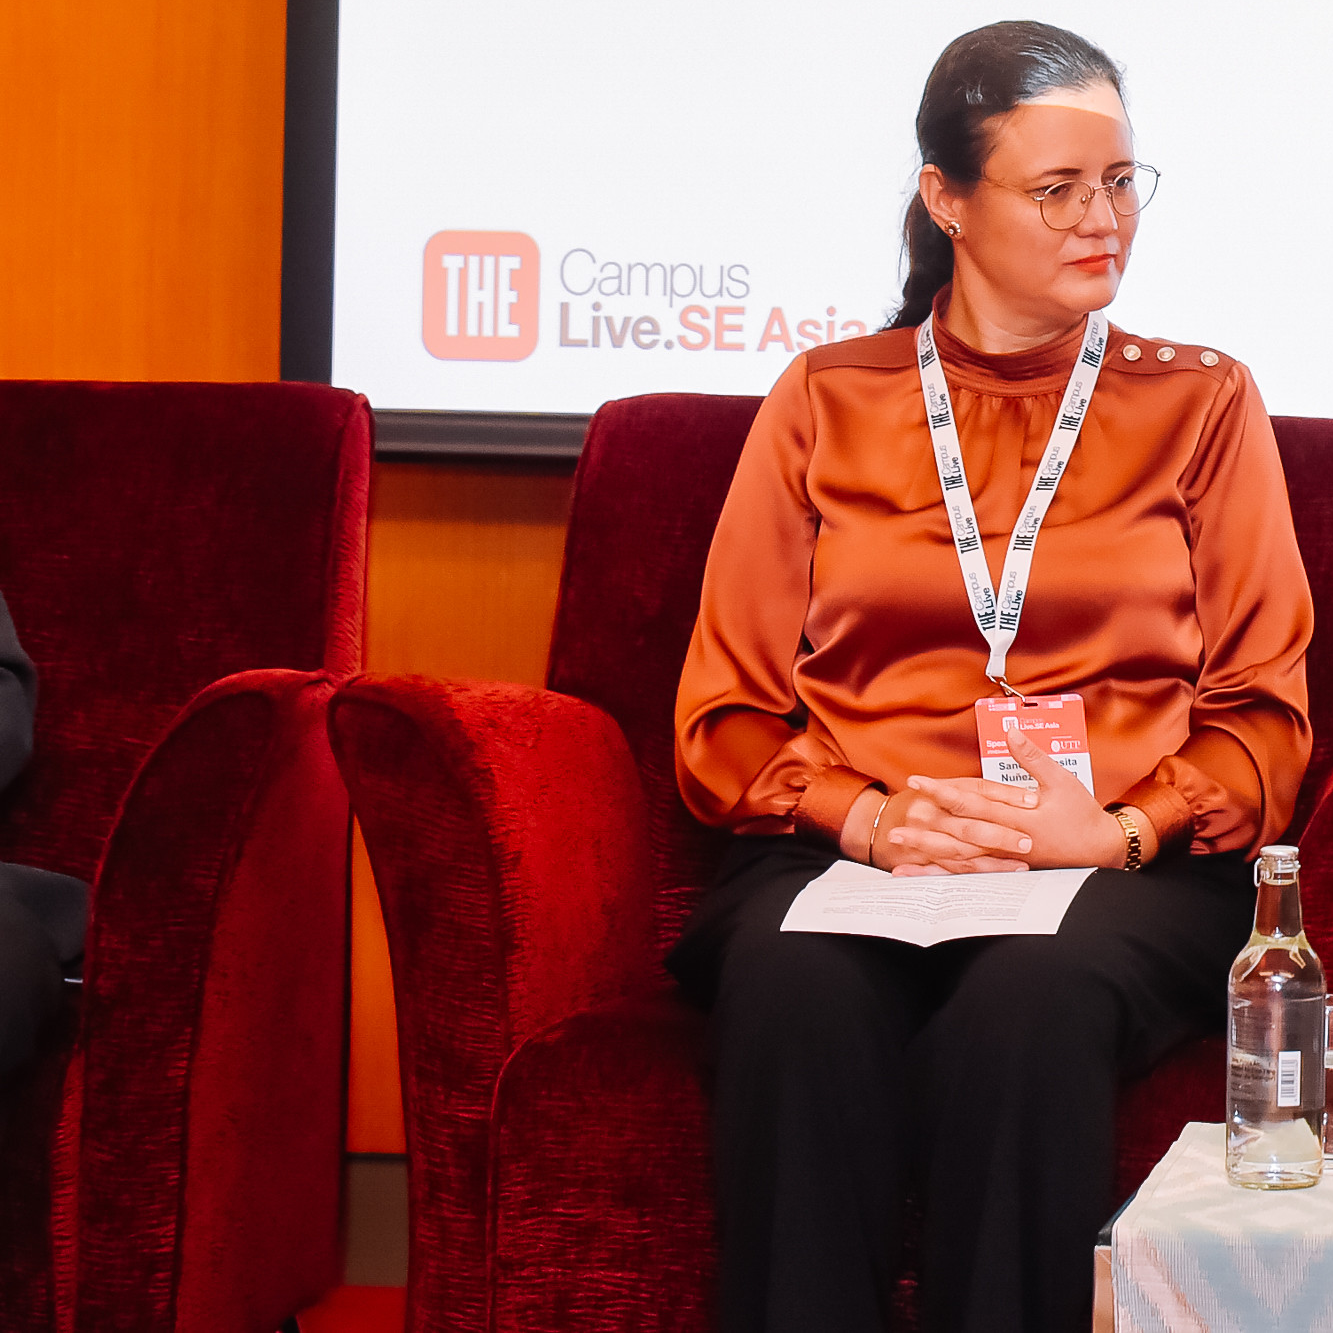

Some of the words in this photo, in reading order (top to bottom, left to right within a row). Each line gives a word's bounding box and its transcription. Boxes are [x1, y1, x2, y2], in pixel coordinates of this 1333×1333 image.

[560, 248, 751, 308] Campus
[442, 254, 521, 337] THE
[559, 301, 745, 352] Live.SE
[1094, 337, 1104, 353] Live
[1081, 347, 1101, 368] THE
[939, 393, 948, 411] Live
[1074, 398, 1087, 416] Live
[931, 411, 951, 430] THE
[1058, 413, 1081, 431] THE
[951, 457, 961, 474] Live
[1050, 460, 1064, 476] Live
[943, 474, 965, 491] THE
[1036, 475, 1058, 491] THE
[965, 517, 975, 535] Live
[1027, 517, 1041, 533] Live
[958, 535, 980, 554] THE
[1013, 534, 1035, 551] THE
[983, 587, 994, 609] Live
[1010, 589, 1023, 611] Live
[977, 609, 997, 631] THE
[999, 610, 1018, 631] THE
